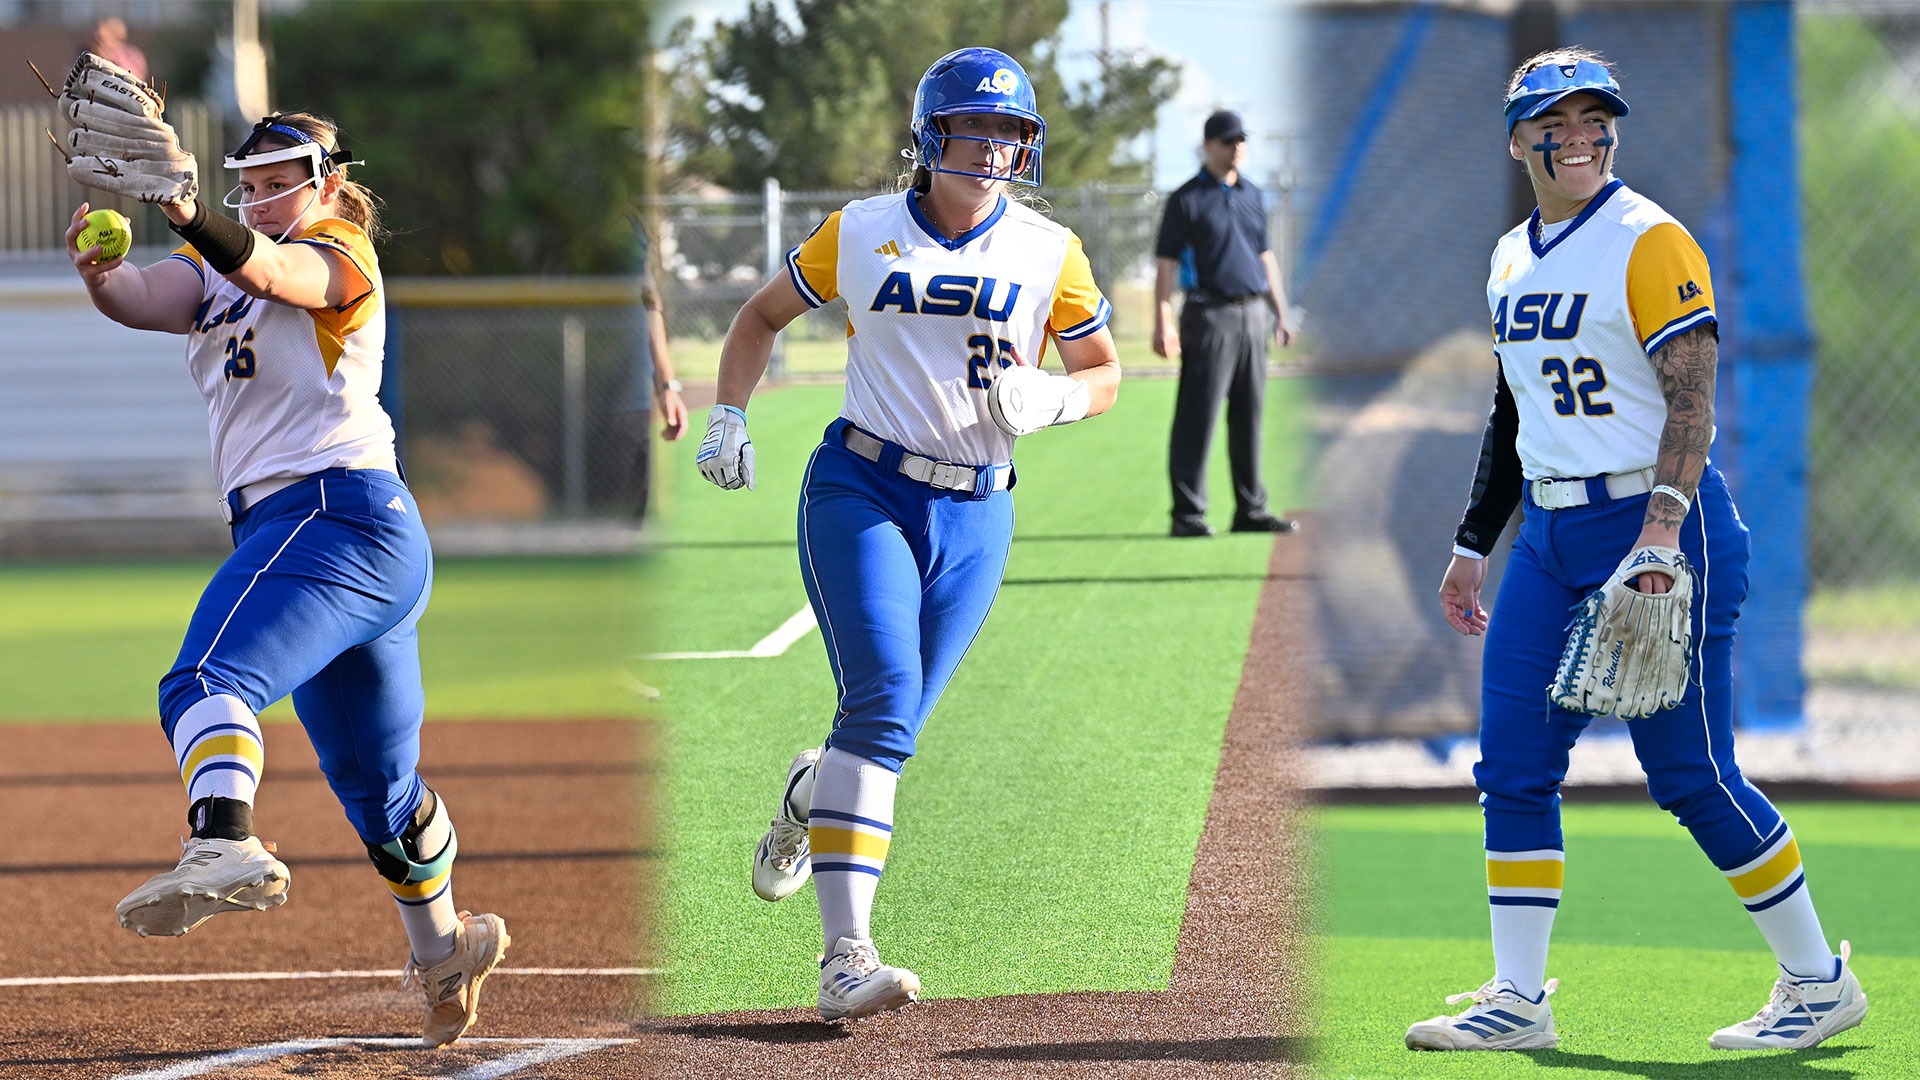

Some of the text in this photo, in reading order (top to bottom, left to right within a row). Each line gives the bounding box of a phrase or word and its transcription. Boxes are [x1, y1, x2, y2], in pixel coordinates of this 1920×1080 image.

[868, 270, 1022, 322] ASU
[1492, 292, 1590, 344] ASU
[1541, 356, 1615, 417] 32
[1602, 640, 1624, 690] Relentless
